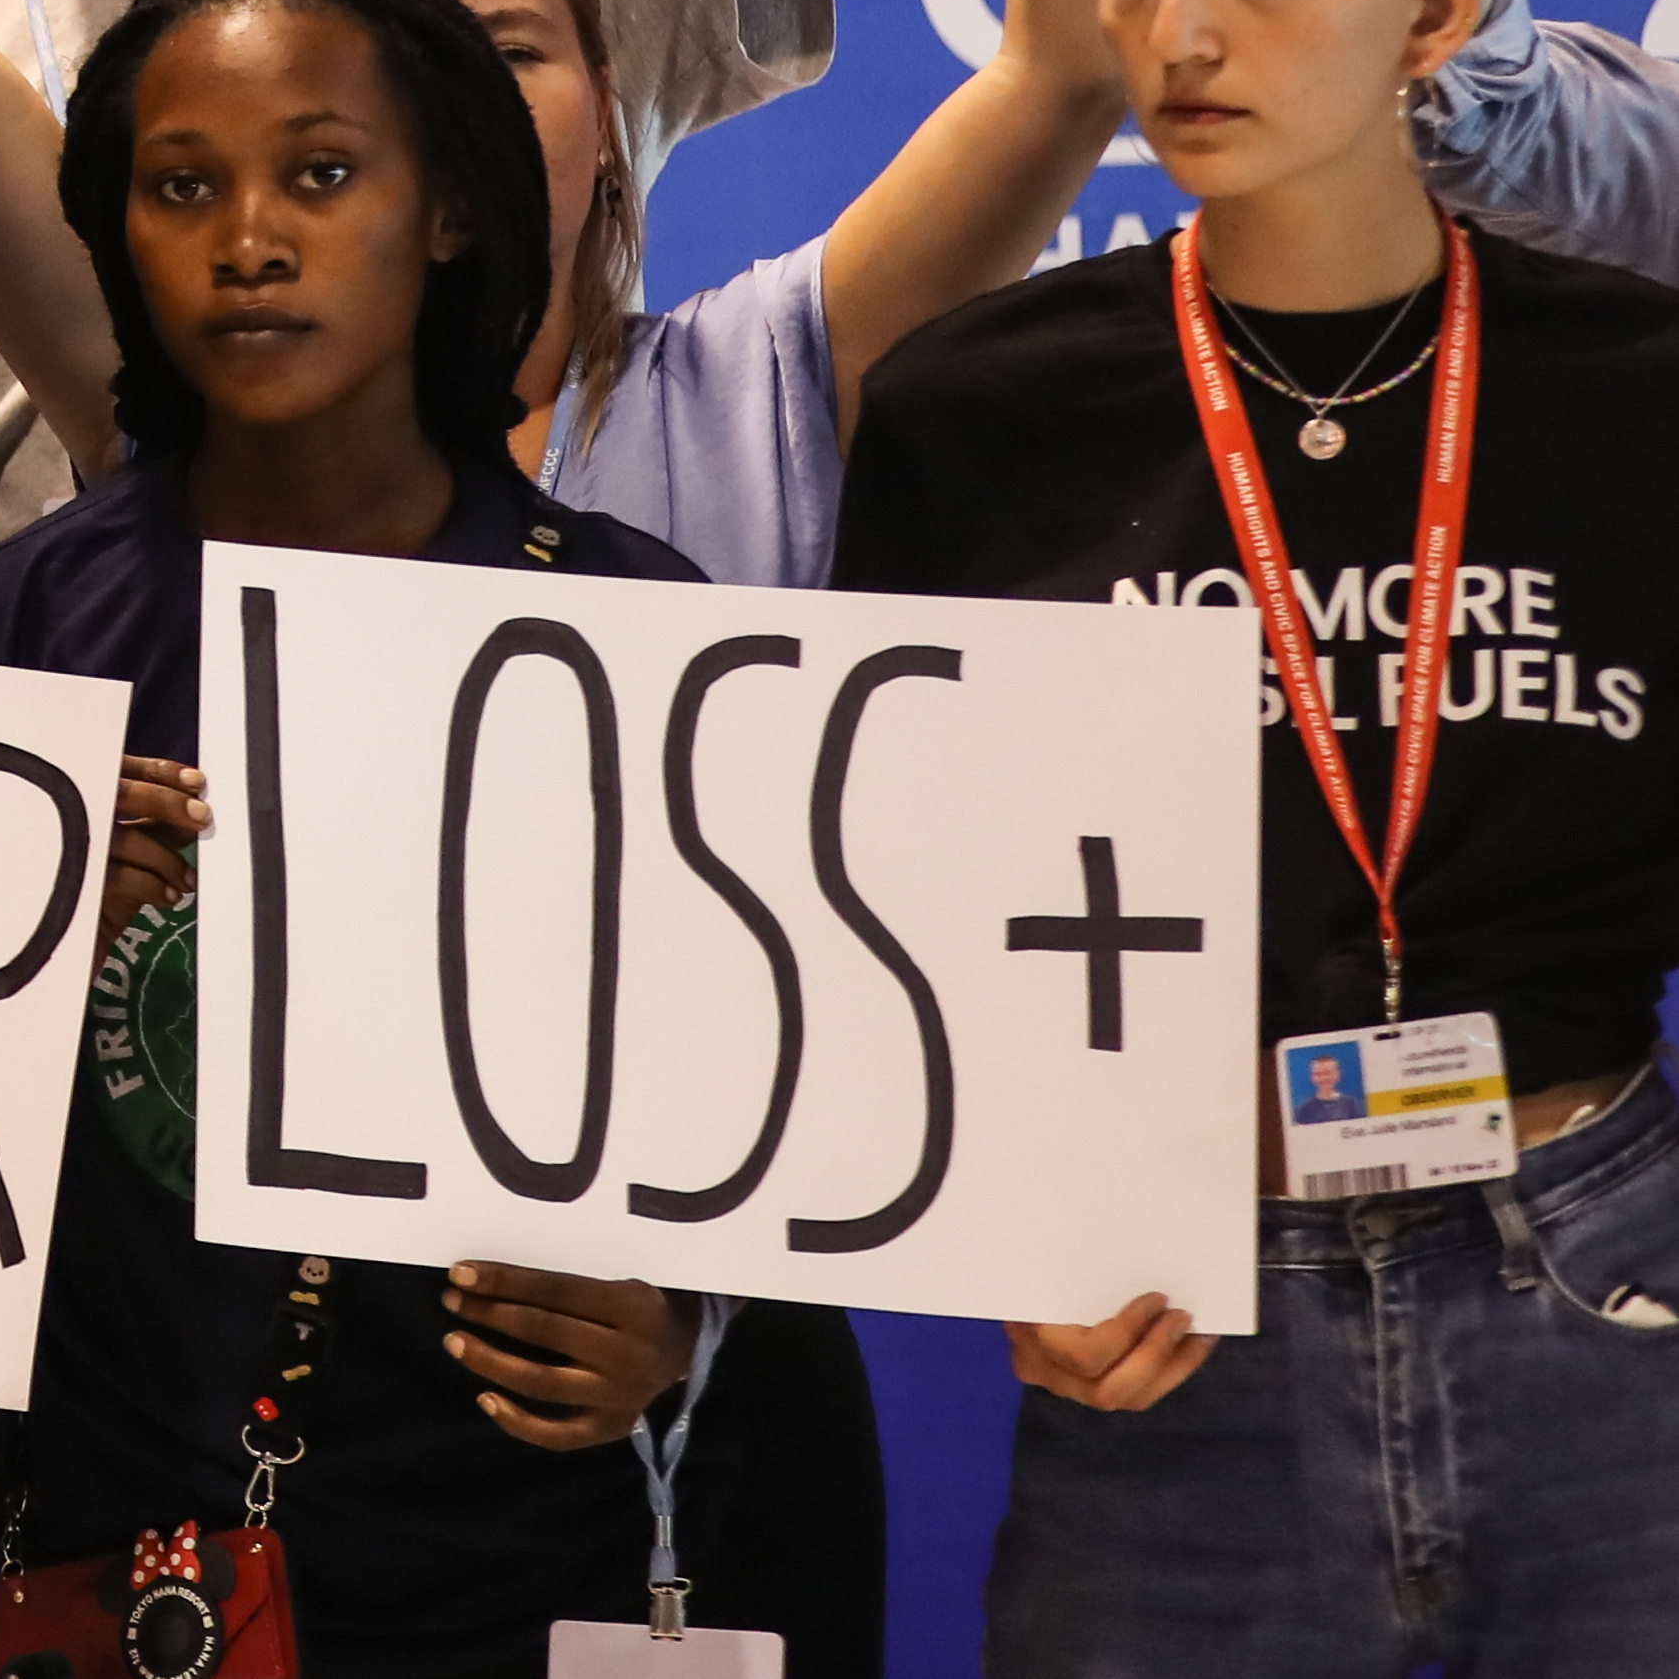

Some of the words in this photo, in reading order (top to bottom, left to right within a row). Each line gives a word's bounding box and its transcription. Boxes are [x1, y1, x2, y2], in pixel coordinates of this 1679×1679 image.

[1201, 361, 1229, 411] ACTION
[538, 447, 560, 494] NFCCC
[1226, 451, 1257, 505] HUMAN
[1436, 431, 1458, 483] HUMAN
[1243, 505, 1272, 558] RIGHTS
[1425, 525, 1448, 579] ACTION
[1259, 560, 1283, 591] AND
[1269, 592, 1293, 631] CIVIC
[1418, 581, 1441, 643] CLIMATE
[1280, 633, 1307, 681] SPACE
[1415, 644, 1434, 675] FOR
[1295, 682, 1317, 711] FOR
[1410, 675, 1432, 722] SPACE
[240, 587, 963, 1253] LOSS
